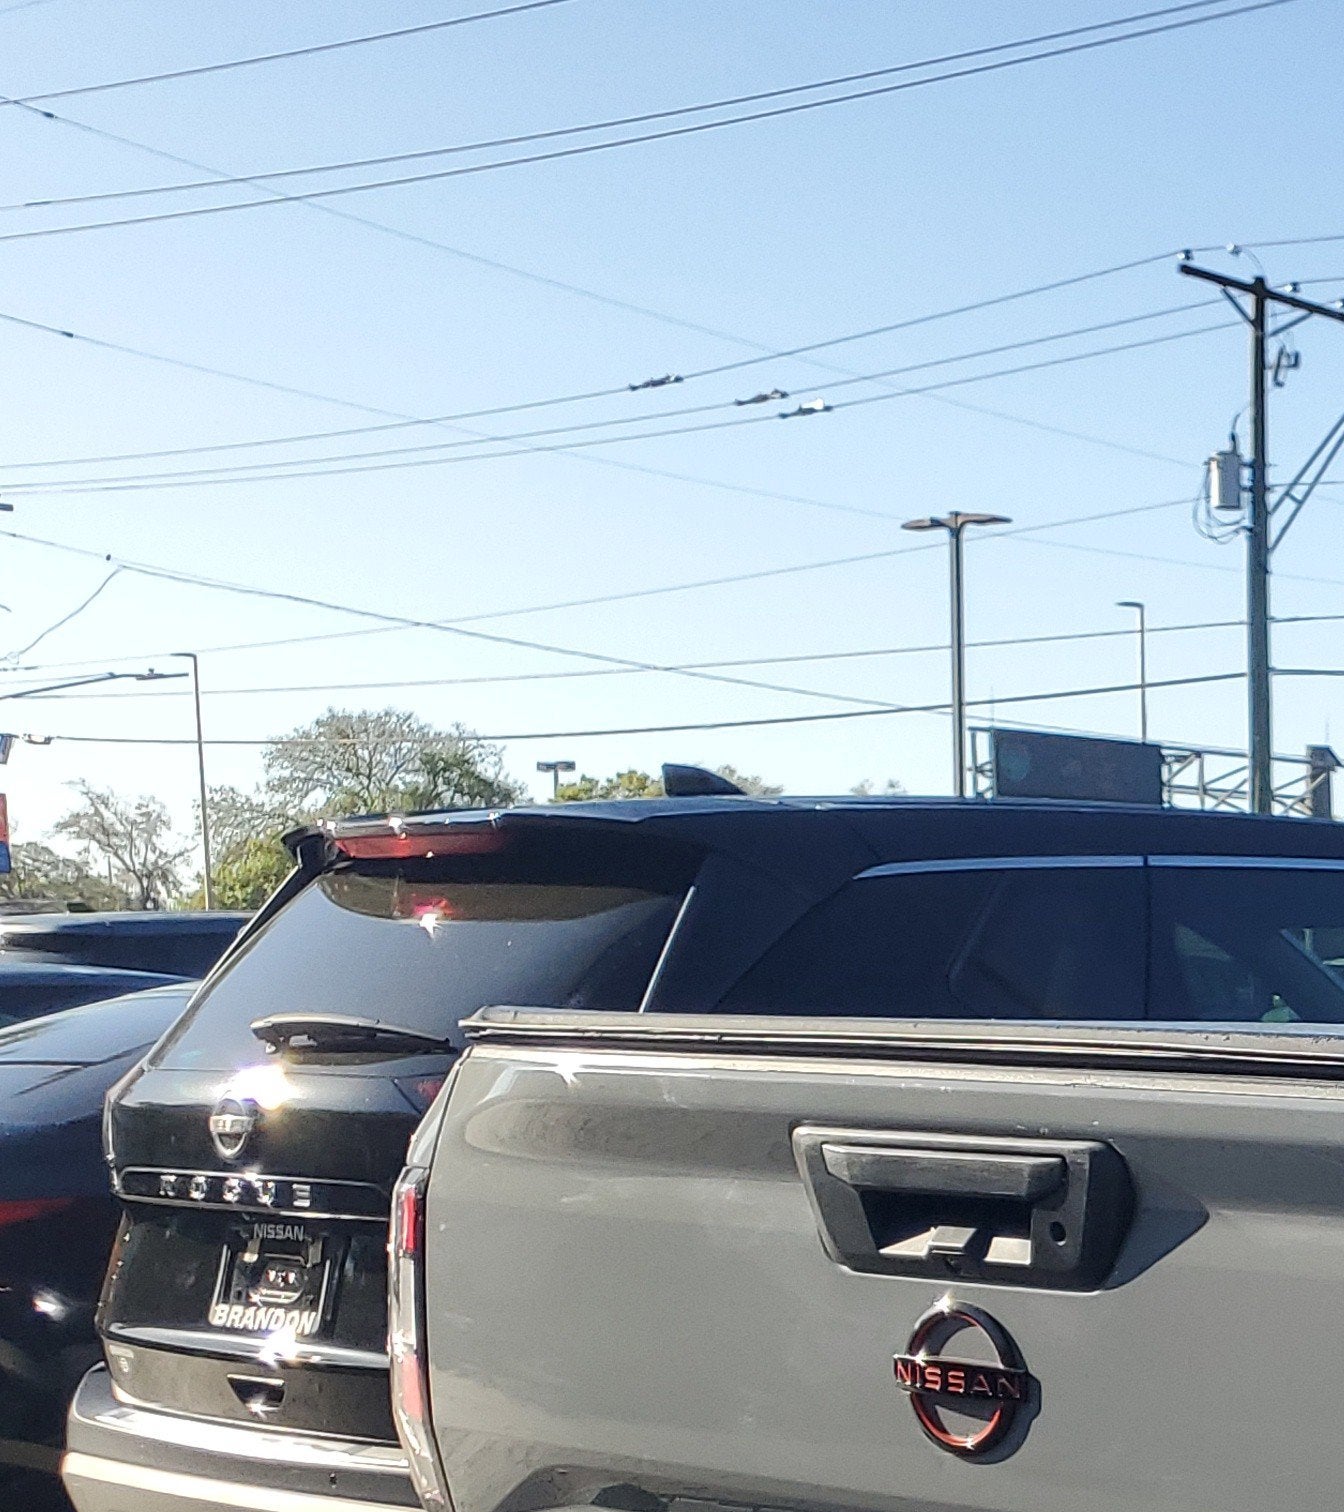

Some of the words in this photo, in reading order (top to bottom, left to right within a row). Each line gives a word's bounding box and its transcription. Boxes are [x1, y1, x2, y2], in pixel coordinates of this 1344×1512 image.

[253, 1223, 305, 1241] NISSAN
[214, 1303, 317, 1334] BRANDON
[895, 1358, 1022, 1399] NISSAN
